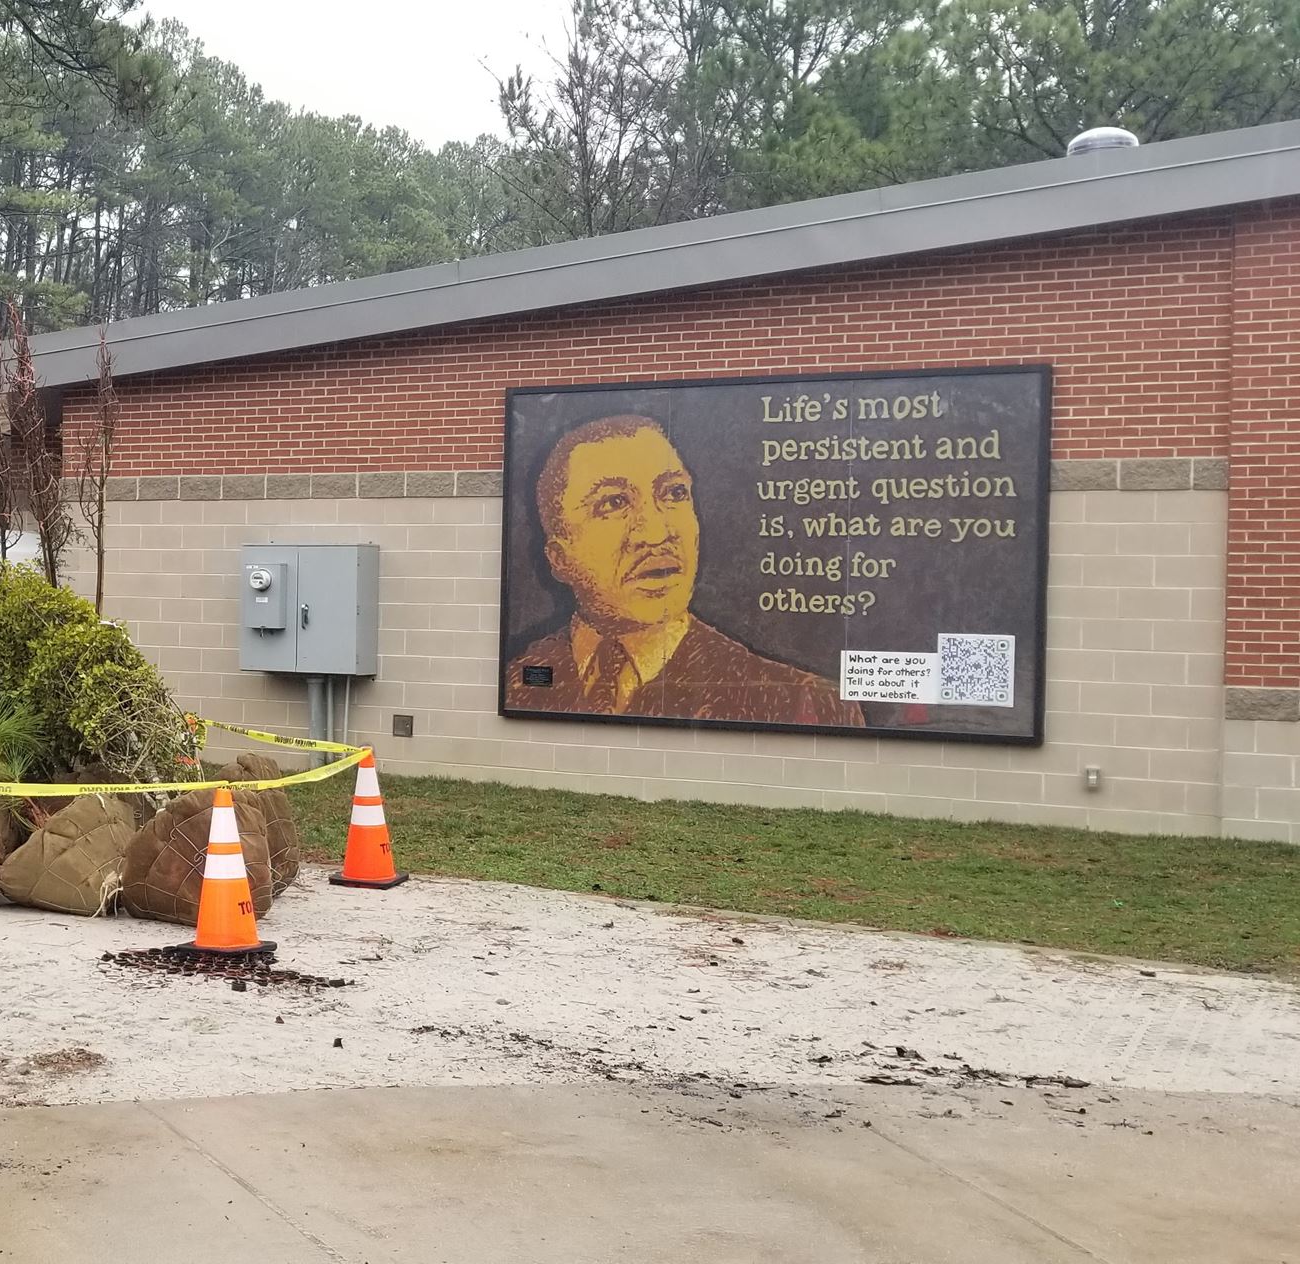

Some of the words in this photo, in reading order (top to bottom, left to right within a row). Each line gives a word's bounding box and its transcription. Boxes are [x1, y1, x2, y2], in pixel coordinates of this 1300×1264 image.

[760, 393, 849, 423] Life's
[857, 390, 944, 420] most
[761, 433, 928, 466] persistent
[935, 429, 1002, 460] and
[756, 476, 861, 505] urgent
[871, 471, 1017, 505] question
[758, 513, 795, 540] is,
[803, 512, 882, 538] what
[889, 516, 943, 537] are
[949, 516, 1017, 543] you
[760, 552, 844, 582] doing
[850, 552, 897, 579] for
[758, 588, 876, 616] others?
[847, 666, 875, 677] doing
[877, 667, 893, 676] for
[894, 667, 931, 677] others?
[849, 654, 878, 664] What
[881, 657, 900, 665] are
[904, 656, 926, 666] you
[846, 677, 863, 686] Tell
[865, 678, 875, 687] us
[878, 679, 906, 688] about
[910, 679, 920, 688] it
[848, 690, 859, 698] on
[880, 690, 920, 700] website.
